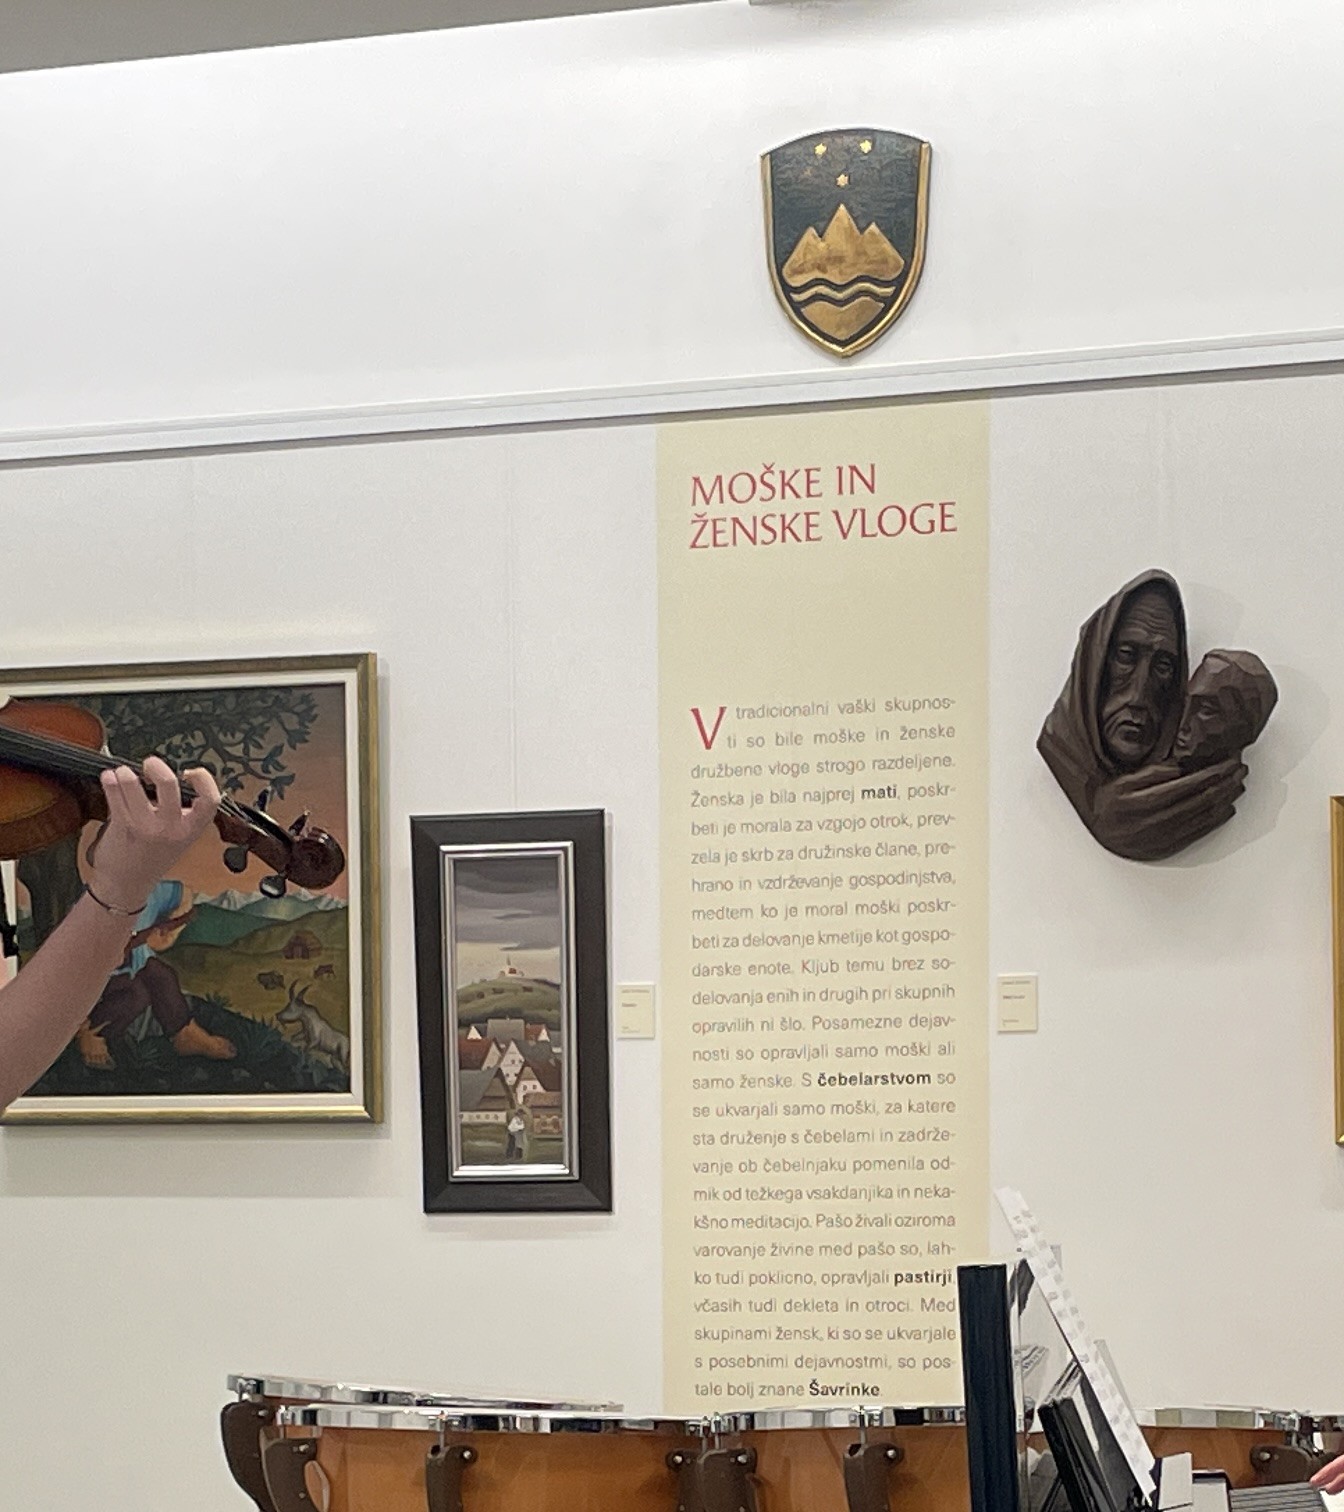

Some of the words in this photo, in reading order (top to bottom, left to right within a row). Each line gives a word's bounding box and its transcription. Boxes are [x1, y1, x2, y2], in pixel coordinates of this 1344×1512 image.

[691, 462, 823, 507] MOŠKE
[836, 463, 876, 495] IN
[689, 511, 822, 550] ŽENSKE
[832, 501, 958, 541] VLOGE
[690, 706, 727, 751] V
[736, 700, 829, 719] tradicionalni
[838, 698, 876, 715] vaški
[727, 732, 736, 749] ti
[747, 734, 765, 748] so
[775, 729, 803, 747] bile
[813, 726, 865, 745] moške
[876, 725, 889, 743] in
[900, 722, 955, 742] ženske
[691, 759, 762, 779] družbene
[768, 757, 810, 779] vloge
[816, 755, 865, 777] strogo
[691, 786, 744, 808] Ženska
[750, 788, 764, 809] je
[770, 786, 796, 805] bila
[803, 784, 855, 807] najprej
[691, 818, 718, 837] beti
[723, 818, 736, 839] je
[741, 816, 791, 835] morala
[796, 819, 813, 832] za
[818, 813, 865, 835] vzgojo
[691, 847, 720, 865] zela
[724, 846, 737, 867] je
[742, 845, 773, 863] skrb
[778, 848, 793, 862] za
[798, 841, 871, 861] družinske
[692, 875, 733, 893] hrano
[739, 874, 751, 892] in
[758, 871, 842, 894] vzdrževanje
[692, 902, 753, 921] medtem
[761, 901, 778, 919] ko
[785, 901, 797, 922] je
[805, 899, 847, 917] moral
[855, 897, 900, 916] moški
[692, 932, 719, 949] beti
[723, 935, 739, 948] za
[743, 929, 814, 951] delovanje
[818, 927, 872, 949] kmetije
[876, 926, 899, 944] kot
[692, 959, 741, 977] darske
[801, 956, 839, 978] Kljub
[846, 955, 884, 973] temu
[892, 954, 924, 972] brez
[692, 987, 763, 1009] delovanja
[767, 986, 798, 1004] enih
[803, 986, 815, 1003] in
[819, 984, 868, 1006] drugih
[872, 984, 891, 1005] pri
[895, 982, 955, 1004] skupnih
[692, 1015, 754, 1037] opravilih
[761, 1015, 774, 1032] ni
[812, 1012, 902, 1031] Posamezne
[692, 1044, 729, 1062] nosti
[736, 1047, 754, 1061] so
[761, 1042, 828, 1064] opravljali
[835, 1045, 878, 1059] samo
[885, 1040, 931, 1058] moški
[937, 1039, 955, 1057] ali
[692, 1076, 734, 1090] samo
[801, 1071, 811, 1088] S
[818, 1068, 931, 1088] čebelarstvom
[937, 1072, 955, 1085] so
[692, 1105, 710, 1118] se
[716, 1100, 778, 1121] ukvarjali
[783, 1103, 825, 1116] samo
[885, 1101, 902, 1115] za
[908, 1097, 955, 1114] katere
[693, 1129, 715, 1146] sta
[720, 1128, 786, 1149] druženje
[792, 1131, 799, 1144] s
[804, 1126, 874, 1144] čebelami
[880, 1126, 893, 1143] in
[693, 1156, 733, 1177] vanje
[738, 1156, 757, 1173] ob
[764, 1155, 846, 1177] čebelnjaku
[853, 1154, 924, 1175] pomenila
[693, 1184, 719, 1202] mik
[723, 1184, 741, 1201] od
[746, 1184, 802, 1205] težkega
[806, 1183, 893, 1204] vsakdanjika
[897, 1183, 910, 1200] in
[694, 1213, 728, 1230] kšno
[816, 1212, 853, 1229] Pašo
[856, 1211, 892, 1229] živali
[895, 1211, 955, 1228] oziroma
[694, 1240, 765, 1261] varovanje
[770, 1240, 813, 1257] živine
[819, 1240, 852, 1257] med
[858, 1239, 894, 1260] pašo
[694, 1268, 711, 1286] ko
[716, 1268, 743, 1285] tudi
[821, 1268, 889, 1288] opravljali
[694, 1296, 742, 1313] včasih
[748, 1296, 776, 1313] tudi
[783, 1296, 839, 1313] dekleta
[846, 1296, 859, 1313] in
[920, 1296, 955, 1313] Med
[695, 1324, 771, 1344] skupinami
[827, 1324, 839, 1341] ki
[843, 1328, 860, 1341] so
[865, 1328, 882, 1341] se
[887, 1324, 955, 1344] ukvarjale
[695, 1356, 702, 1369] s
[709, 1352, 788, 1372] posebnimi
[898, 1356, 916, 1369] so
[695, 1380, 722, 1397] tale
[727, 1380, 754, 1400] bolj
[758, 1384, 804, 1397] znane
